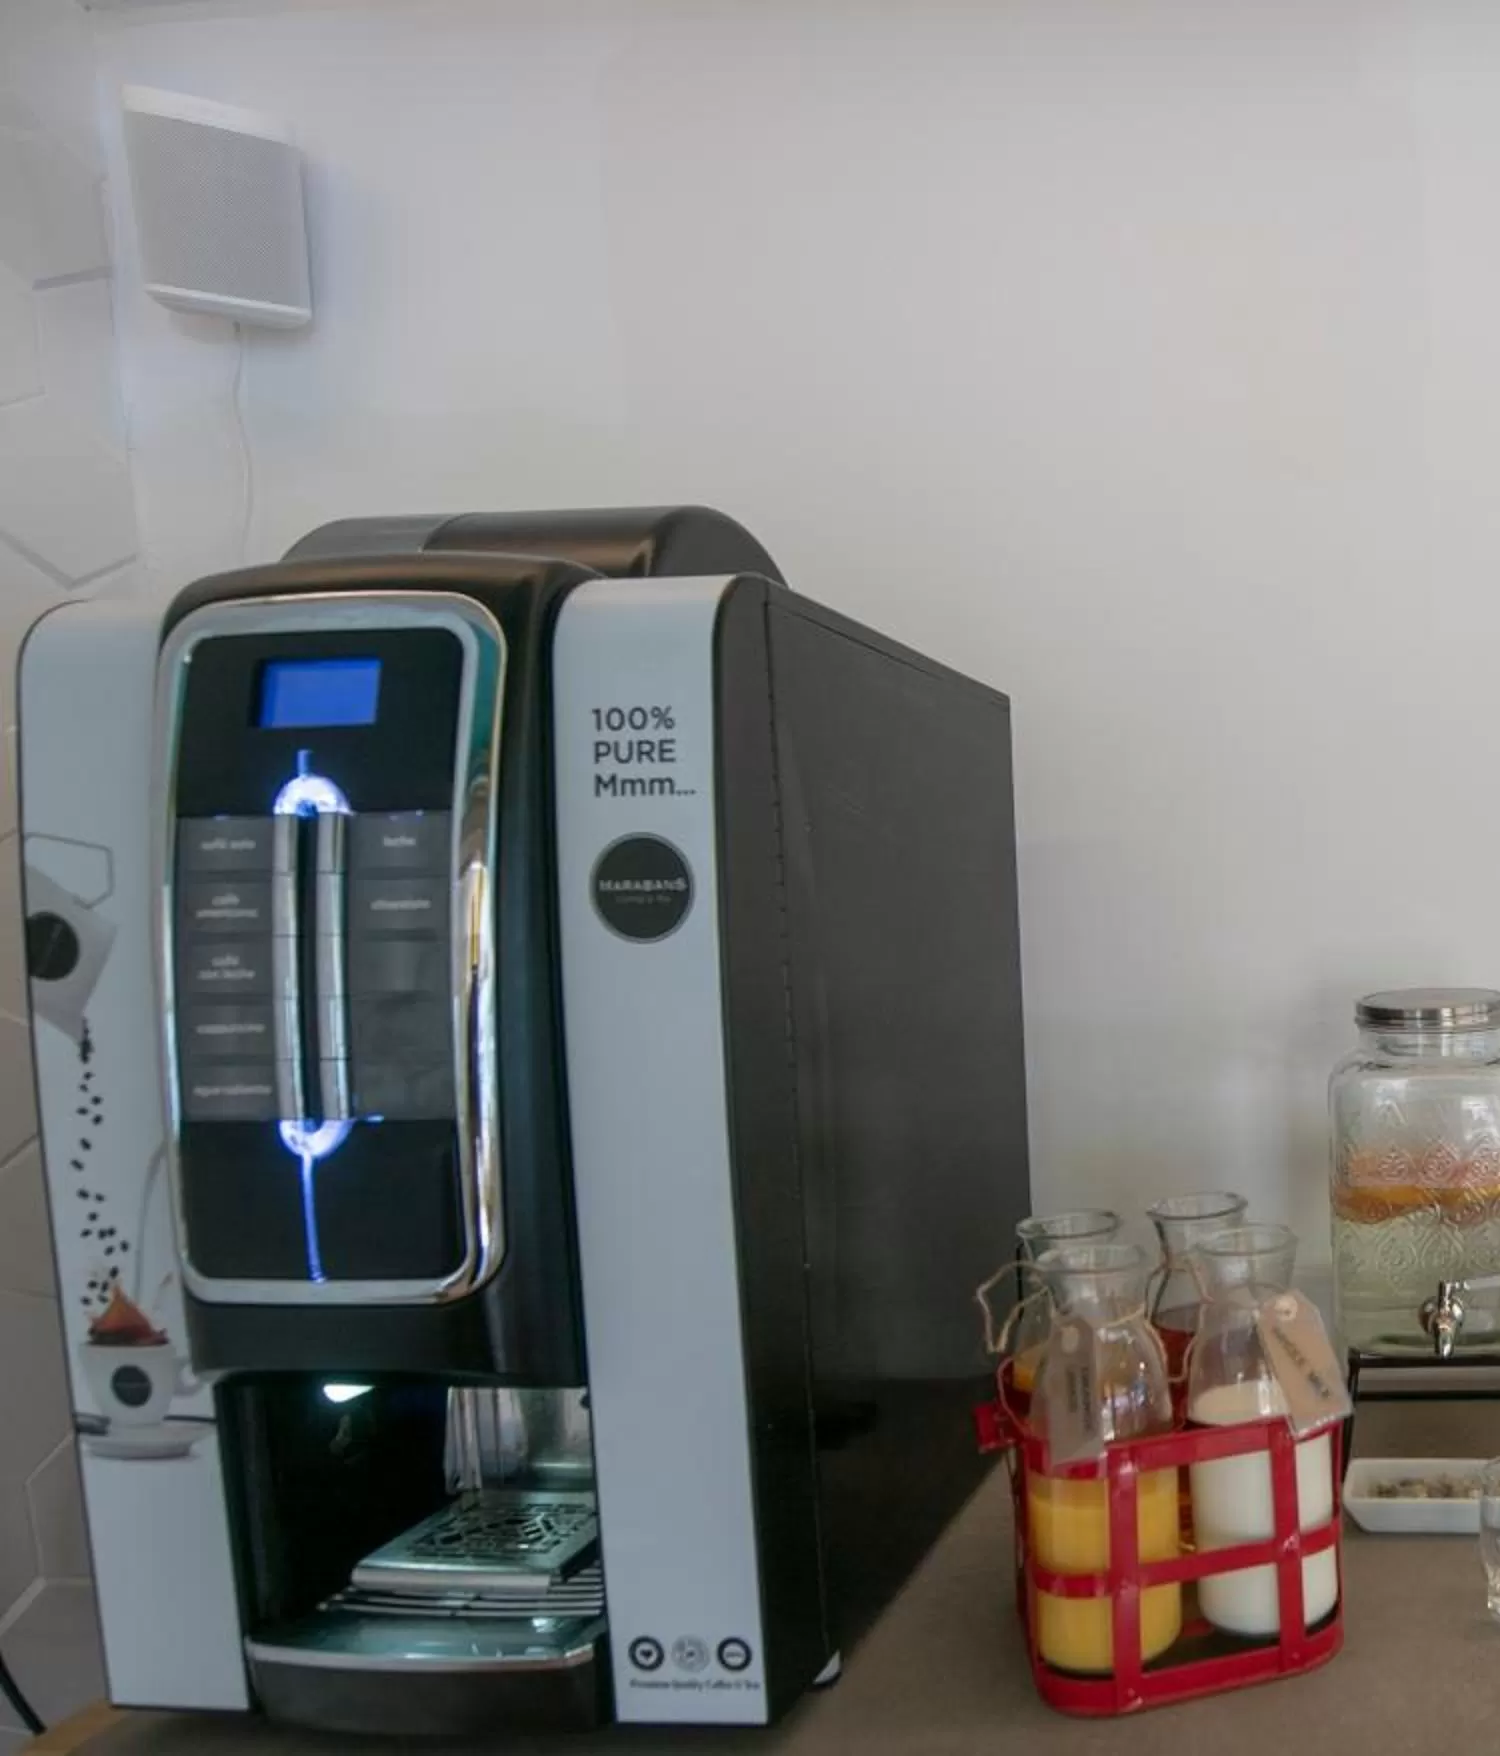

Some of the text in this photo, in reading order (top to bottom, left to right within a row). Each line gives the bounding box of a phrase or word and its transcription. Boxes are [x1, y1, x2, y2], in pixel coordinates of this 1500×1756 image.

[592, 706, 676, 732] 100%
[594, 738, 677, 764] PURE
[594, 773, 697, 798] Mmm...
